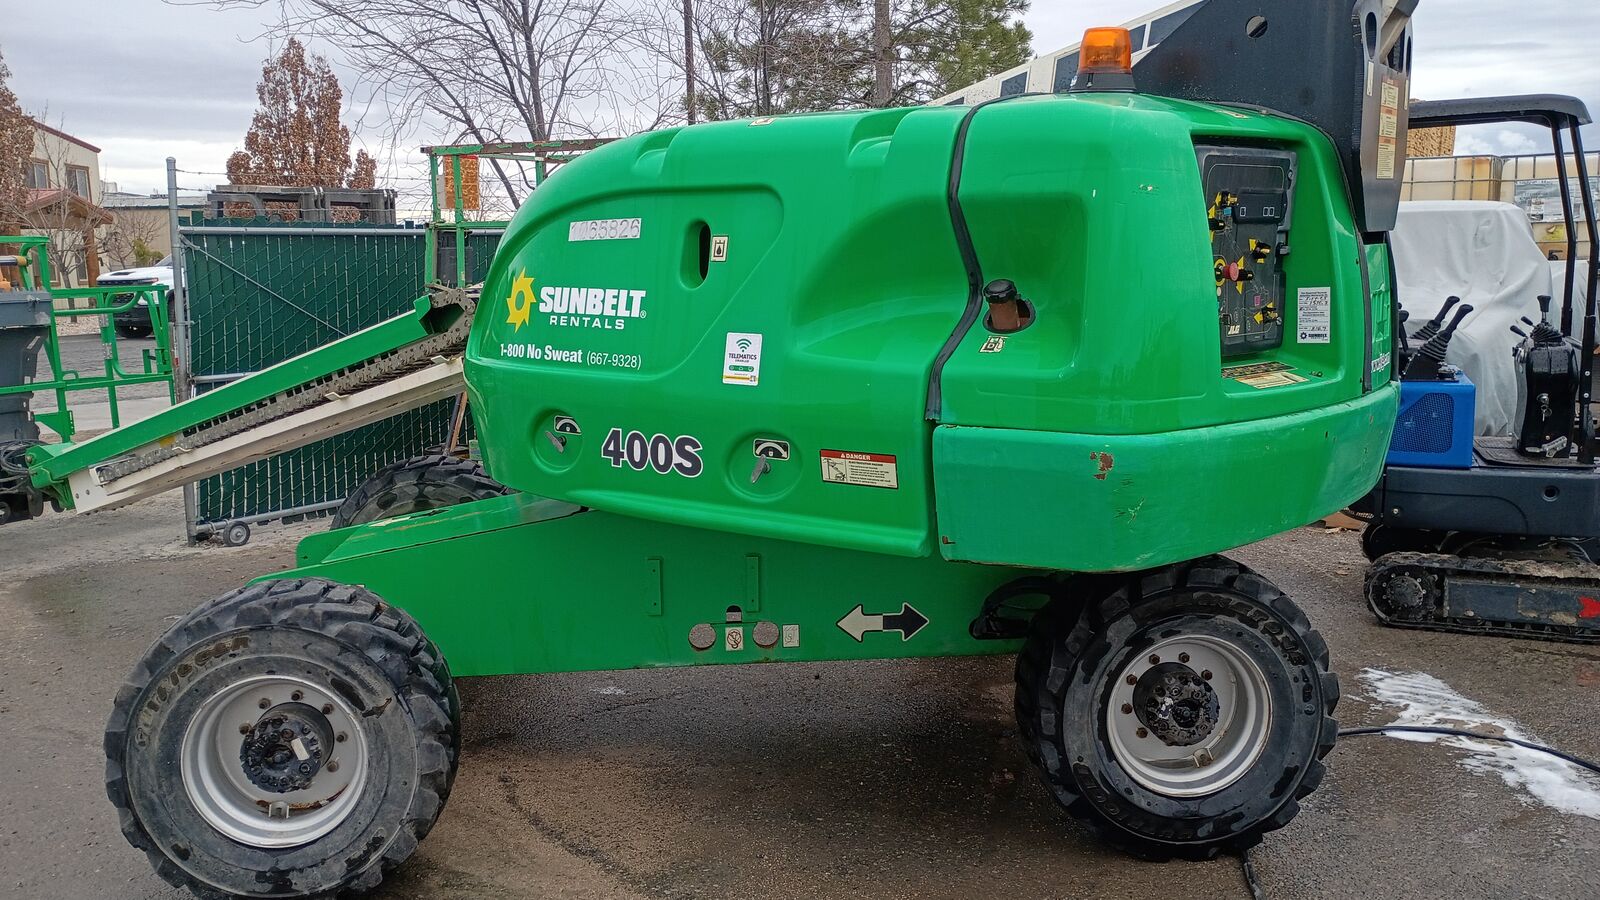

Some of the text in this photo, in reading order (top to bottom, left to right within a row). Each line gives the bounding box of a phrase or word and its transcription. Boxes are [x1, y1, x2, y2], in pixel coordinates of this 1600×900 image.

[539, 286, 647, 318] SUNBELT
[549, 315, 625, 330] RENTALS
[500, 343, 642, 371] 1-800 No Sweat (667-9328)
[728, 352, 757, 361] TELEMATICS
[601, 427, 704, 478] 400S
